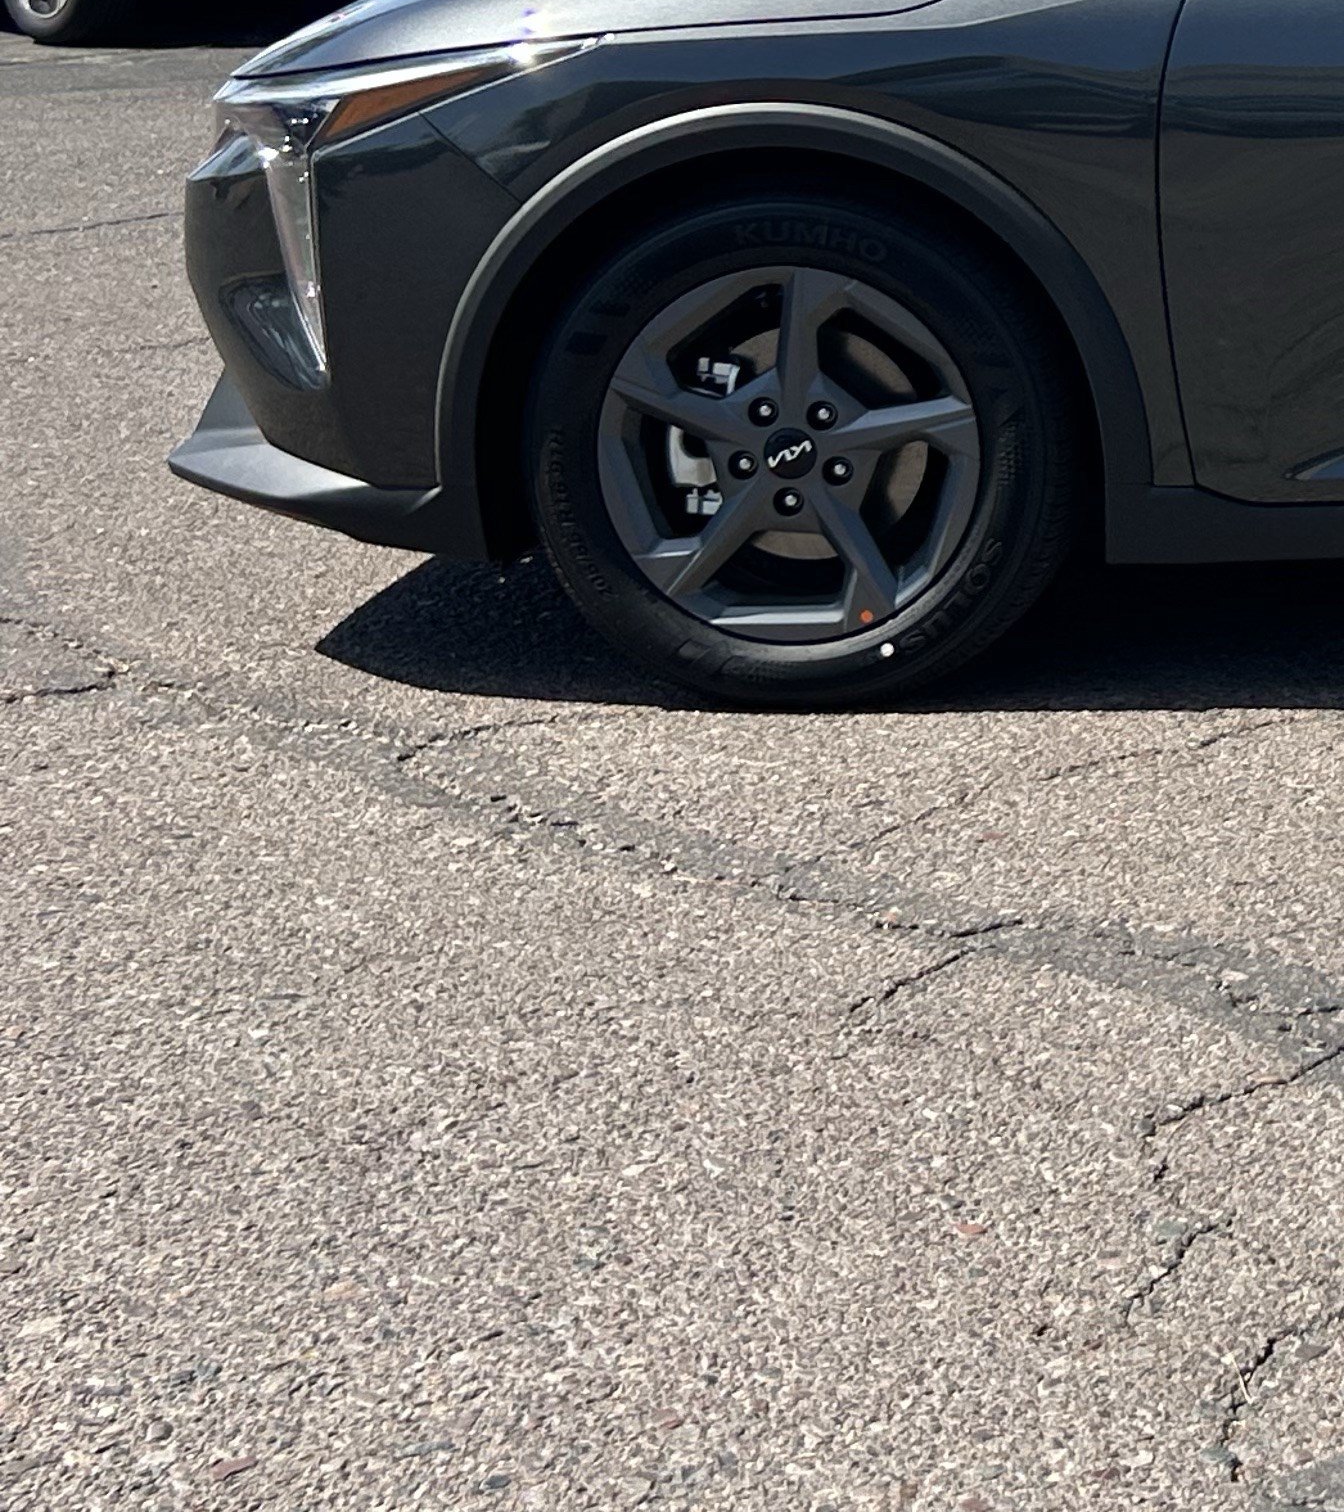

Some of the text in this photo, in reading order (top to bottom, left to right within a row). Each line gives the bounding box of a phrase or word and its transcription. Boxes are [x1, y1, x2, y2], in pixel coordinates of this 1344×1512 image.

[734, 220, 888, 262] KUMHO
[767, 440, 813, 468] KIA
[895, 535, 1007, 659] SOLUS
